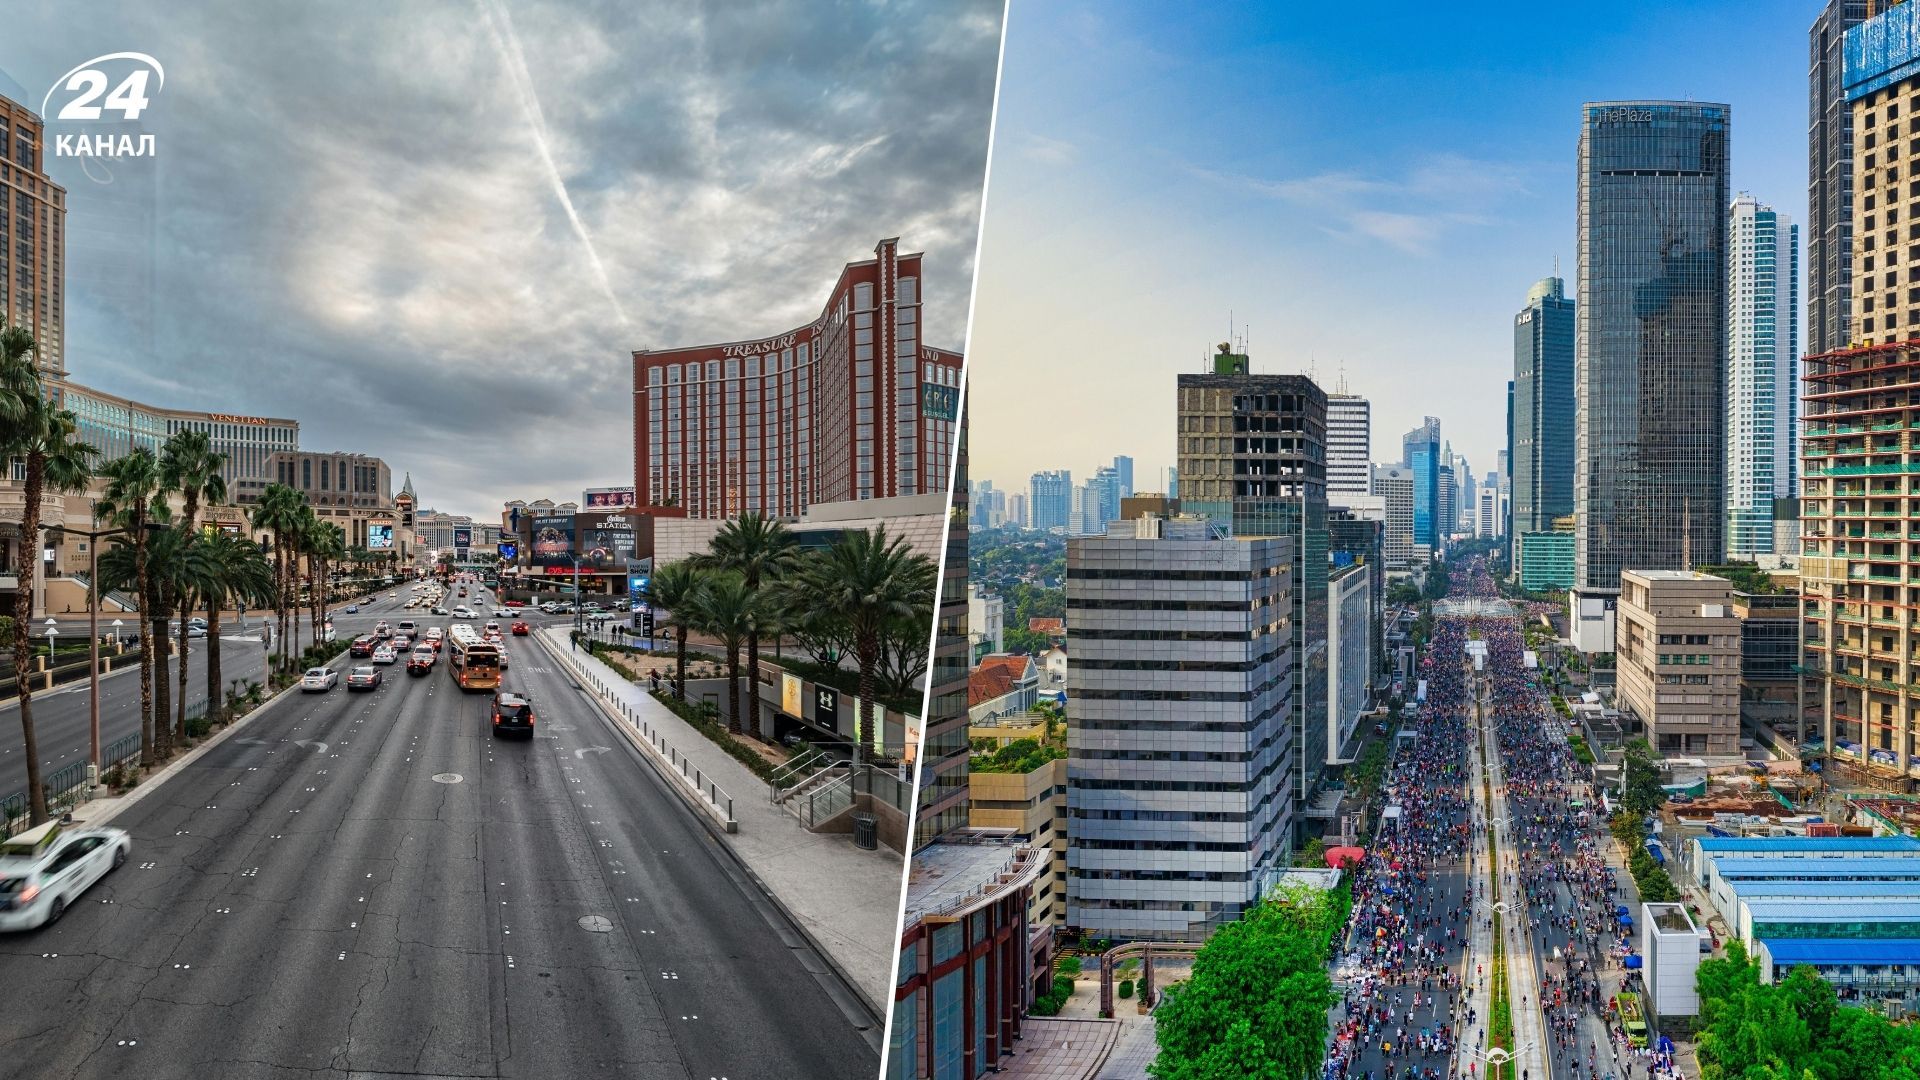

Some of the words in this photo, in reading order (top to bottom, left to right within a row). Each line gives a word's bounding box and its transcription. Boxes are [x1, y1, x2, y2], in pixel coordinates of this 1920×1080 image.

[1598, 107, 1653, 122] ThePlaza
[723, 333, 797, 357] TREASURE
[210, 413, 266, 425] VENETIAN
